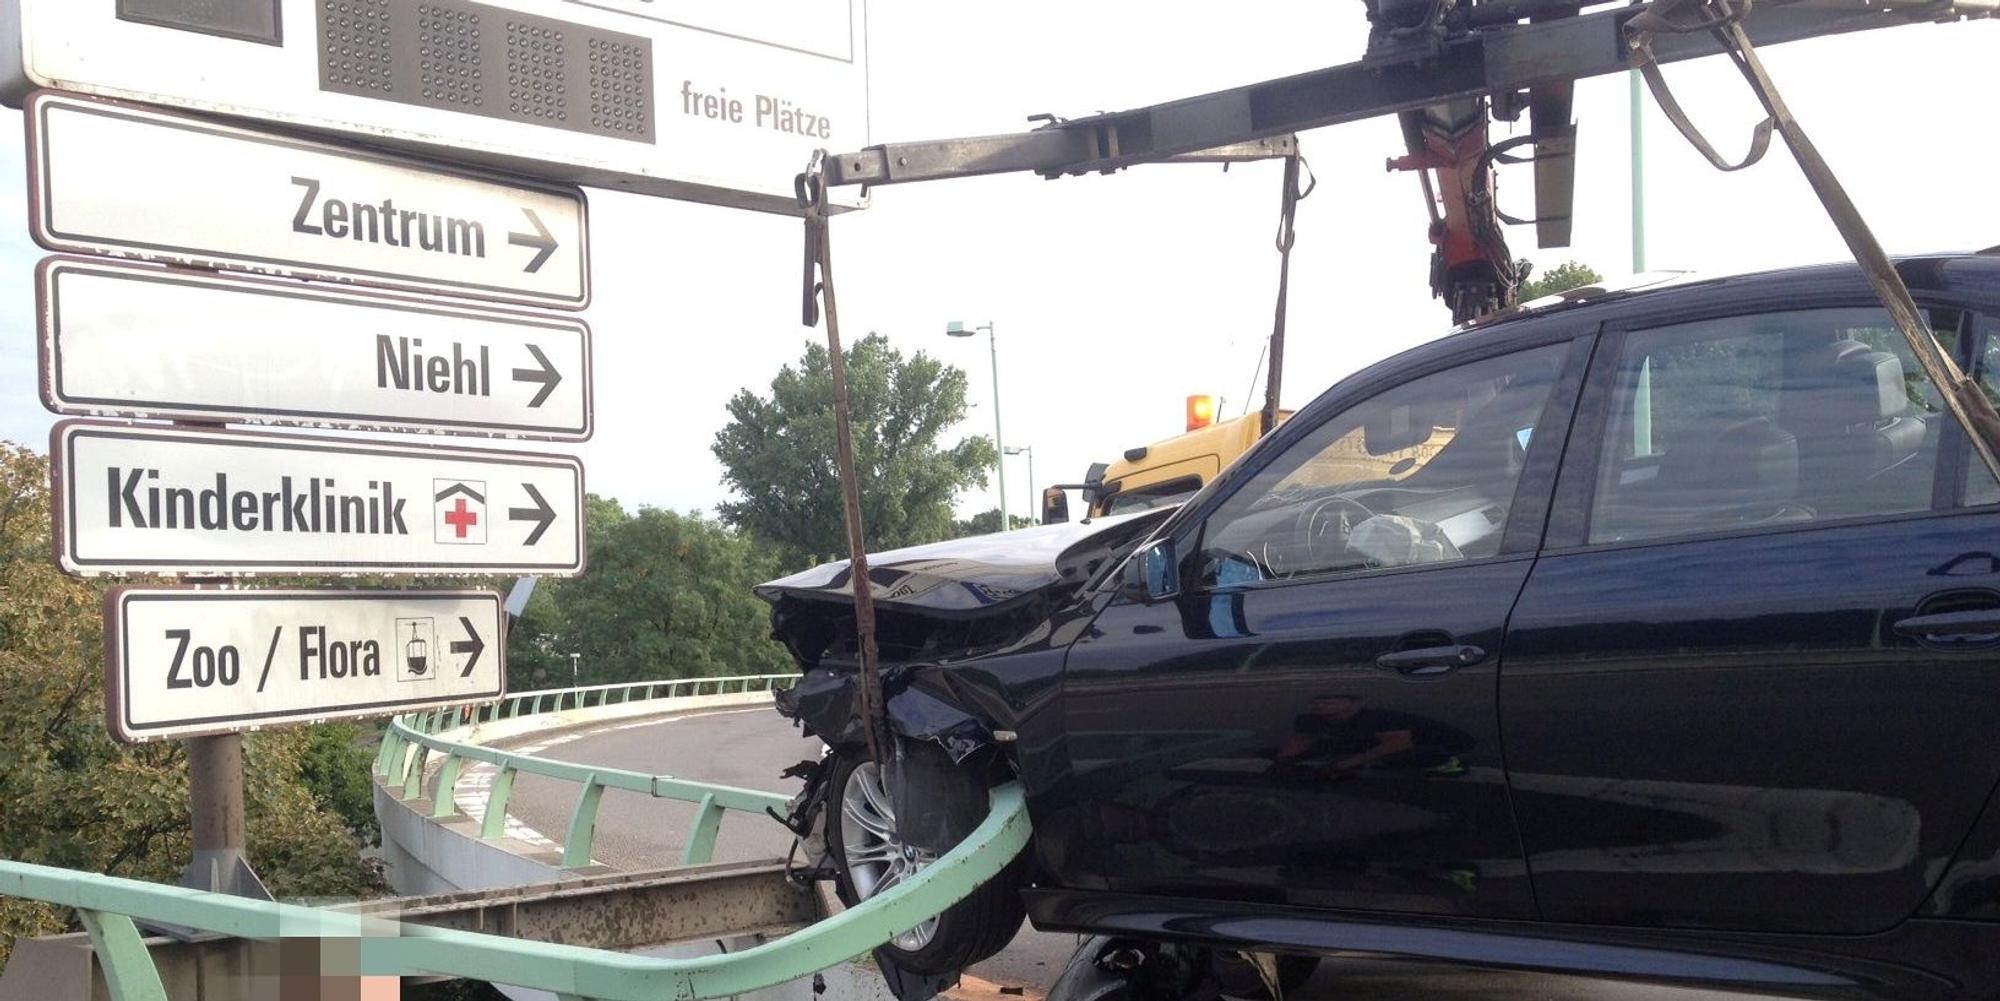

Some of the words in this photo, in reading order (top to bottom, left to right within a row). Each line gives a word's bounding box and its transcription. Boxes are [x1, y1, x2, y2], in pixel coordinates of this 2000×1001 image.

[681, 80, 743, 123] freie
[755, 95, 831, 139] Plätze
[291, 176, 486, 259] Zentrum
[376, 334, 490, 397] Niehl
[107, 467, 408, 535] Kinderklinik
[165, 629, 240, 689] Zoo
[257, 626, 282, 692] /
[299, 626, 380, 681] Flora
